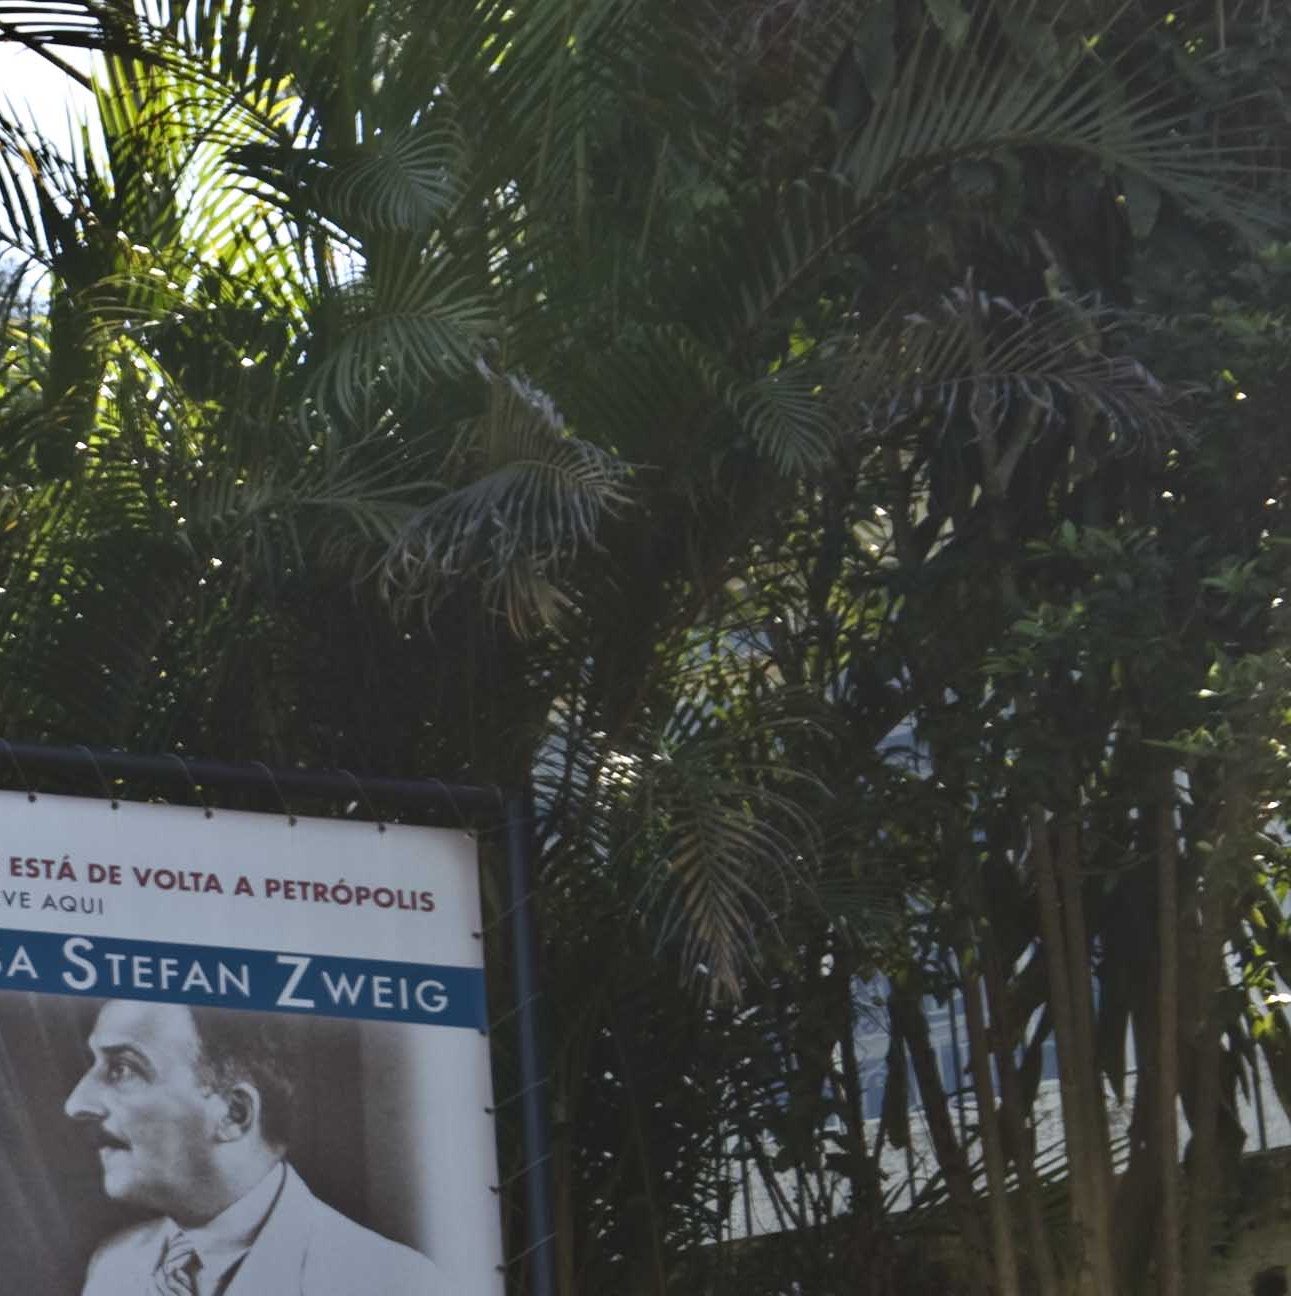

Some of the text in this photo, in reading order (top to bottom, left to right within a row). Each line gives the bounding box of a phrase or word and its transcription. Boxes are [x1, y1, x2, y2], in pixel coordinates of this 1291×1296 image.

[10, 855, 77, 881] ESTÁ
[88, 863, 122, 886] DE
[132, 867, 223, 894] VOLTA
[233, 876, 255, 897] A
[265, 878, 435, 912] PETRÓPOLIS
[41, 894, 104, 915] AQUI
[62, 937, 251, 997] STEFAN
[275, 954, 448, 1013] ZWEIG
